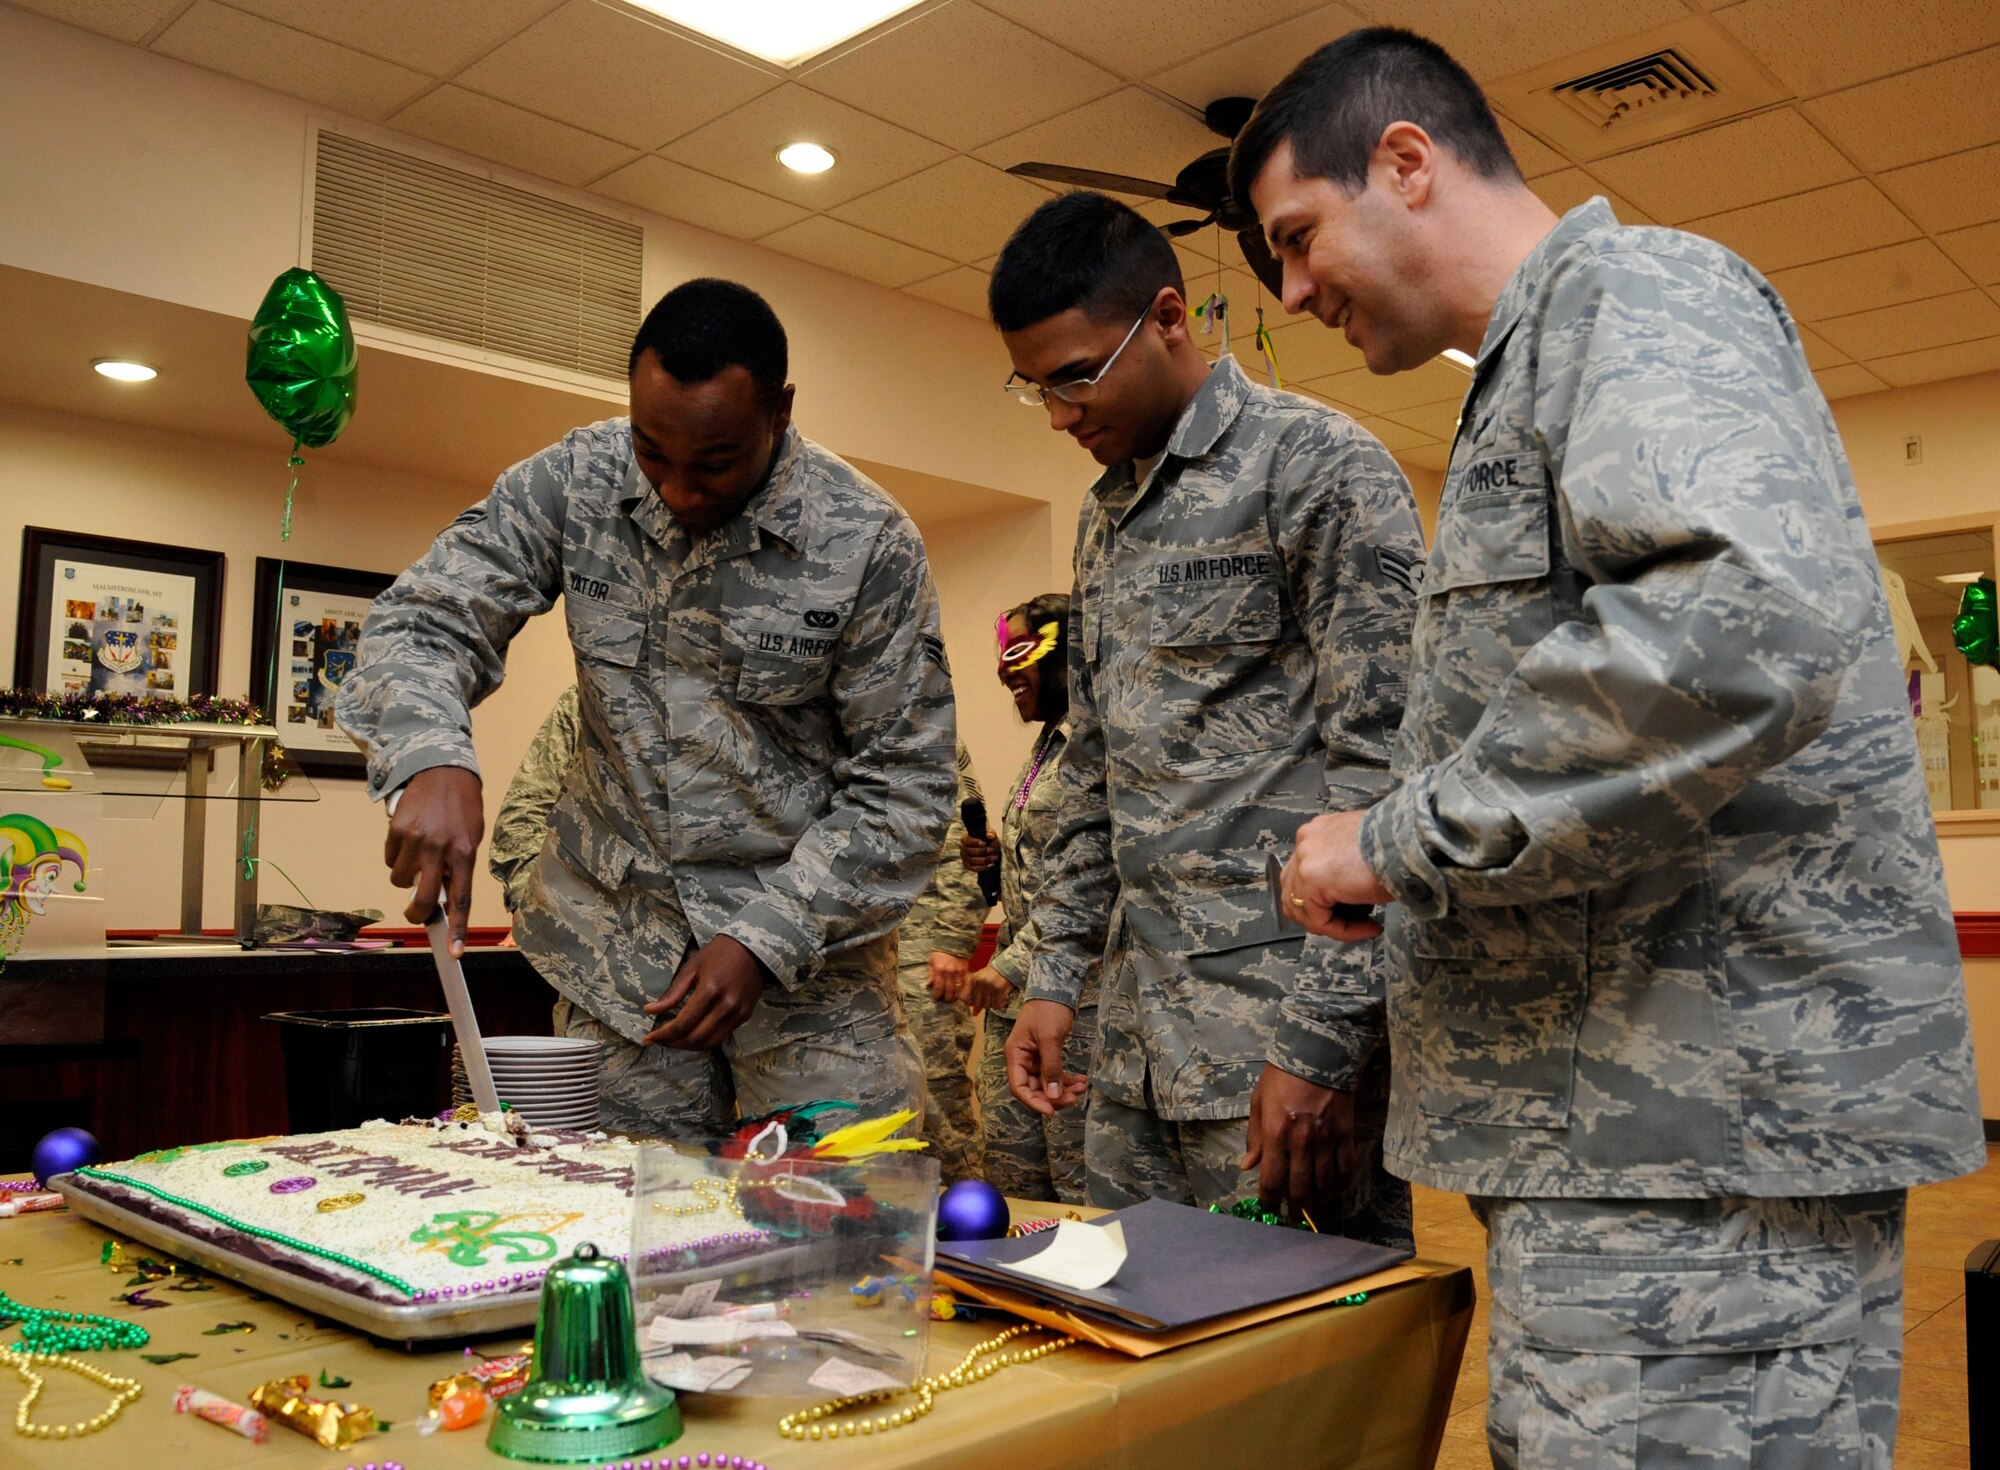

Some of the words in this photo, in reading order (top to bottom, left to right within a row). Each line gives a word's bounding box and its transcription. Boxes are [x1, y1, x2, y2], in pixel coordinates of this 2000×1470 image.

[1160, 564, 1183, 583] U.S.
[1185, 561, 1207, 582] AIR
[1209, 556, 1270, 578] FORCE
[93, 584, 136, 593] MALMSTROM
[759, 633, 785, 653] U.S.
[789, 637, 814, 656] AIR
